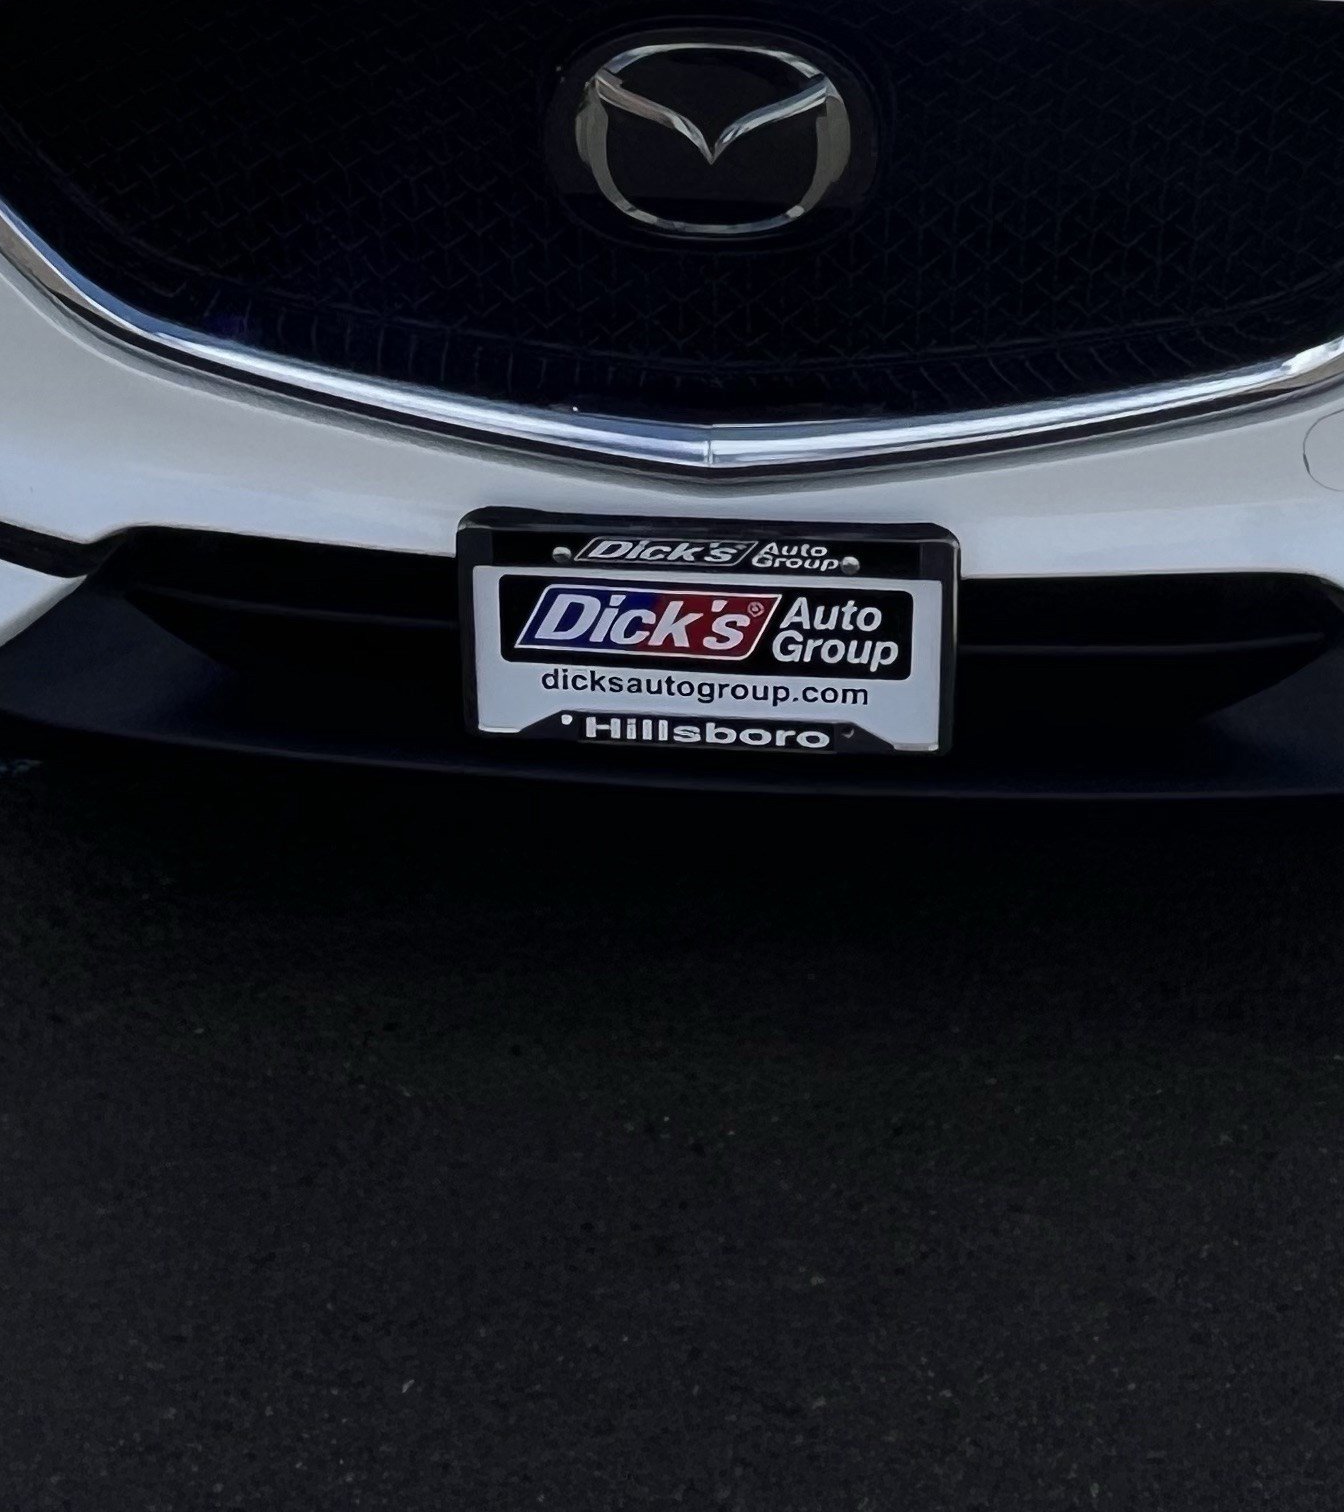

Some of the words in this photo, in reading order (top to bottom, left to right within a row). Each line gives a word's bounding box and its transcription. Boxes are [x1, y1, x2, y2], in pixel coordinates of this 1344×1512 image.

[587, 539, 741, 562] Dick's
[759, 541, 828, 557] Auto
[752, 555, 838, 572] Group
[534, 592, 751, 650] Dick's
[780, 596, 882, 632] Auto
[772, 630, 899, 672] Group
[541, 668, 870, 706] dicksautogroup.com
[585, 714, 831, 748] Hillsboro
